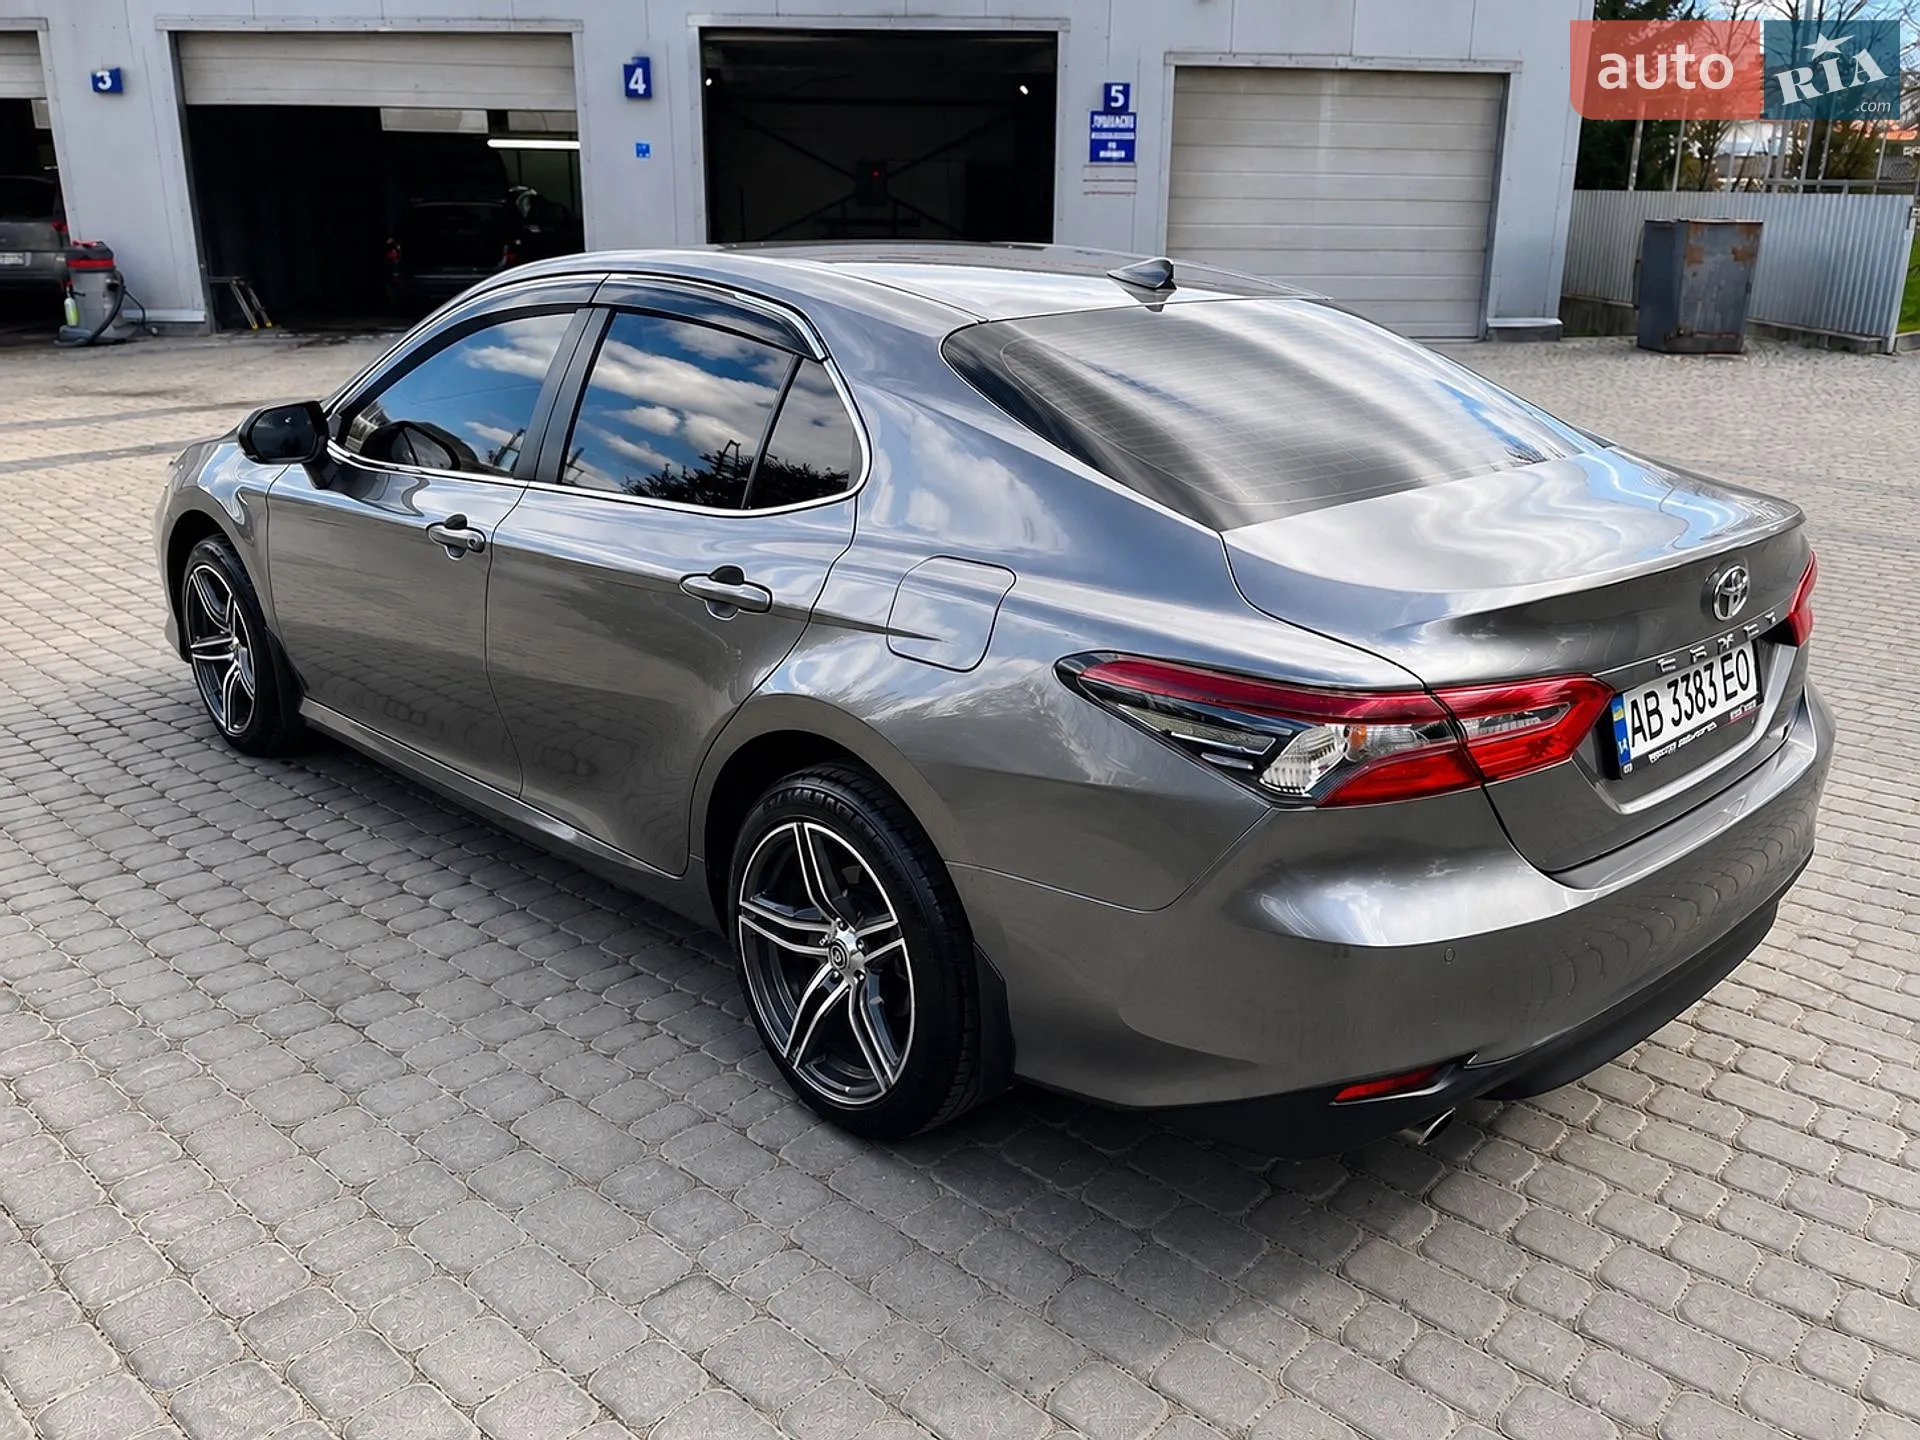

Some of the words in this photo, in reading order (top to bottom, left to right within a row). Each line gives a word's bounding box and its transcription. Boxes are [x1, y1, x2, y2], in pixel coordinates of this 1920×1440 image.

[96, 71, 112, 90] 3
[628, 67, 647, 95] 4
[1109, 84, 1125, 108] 5
[1629, 690, 1664, 749] AB
[1666, 661, 1719, 727] 3383
[1719, 648, 1751, 702] EO
